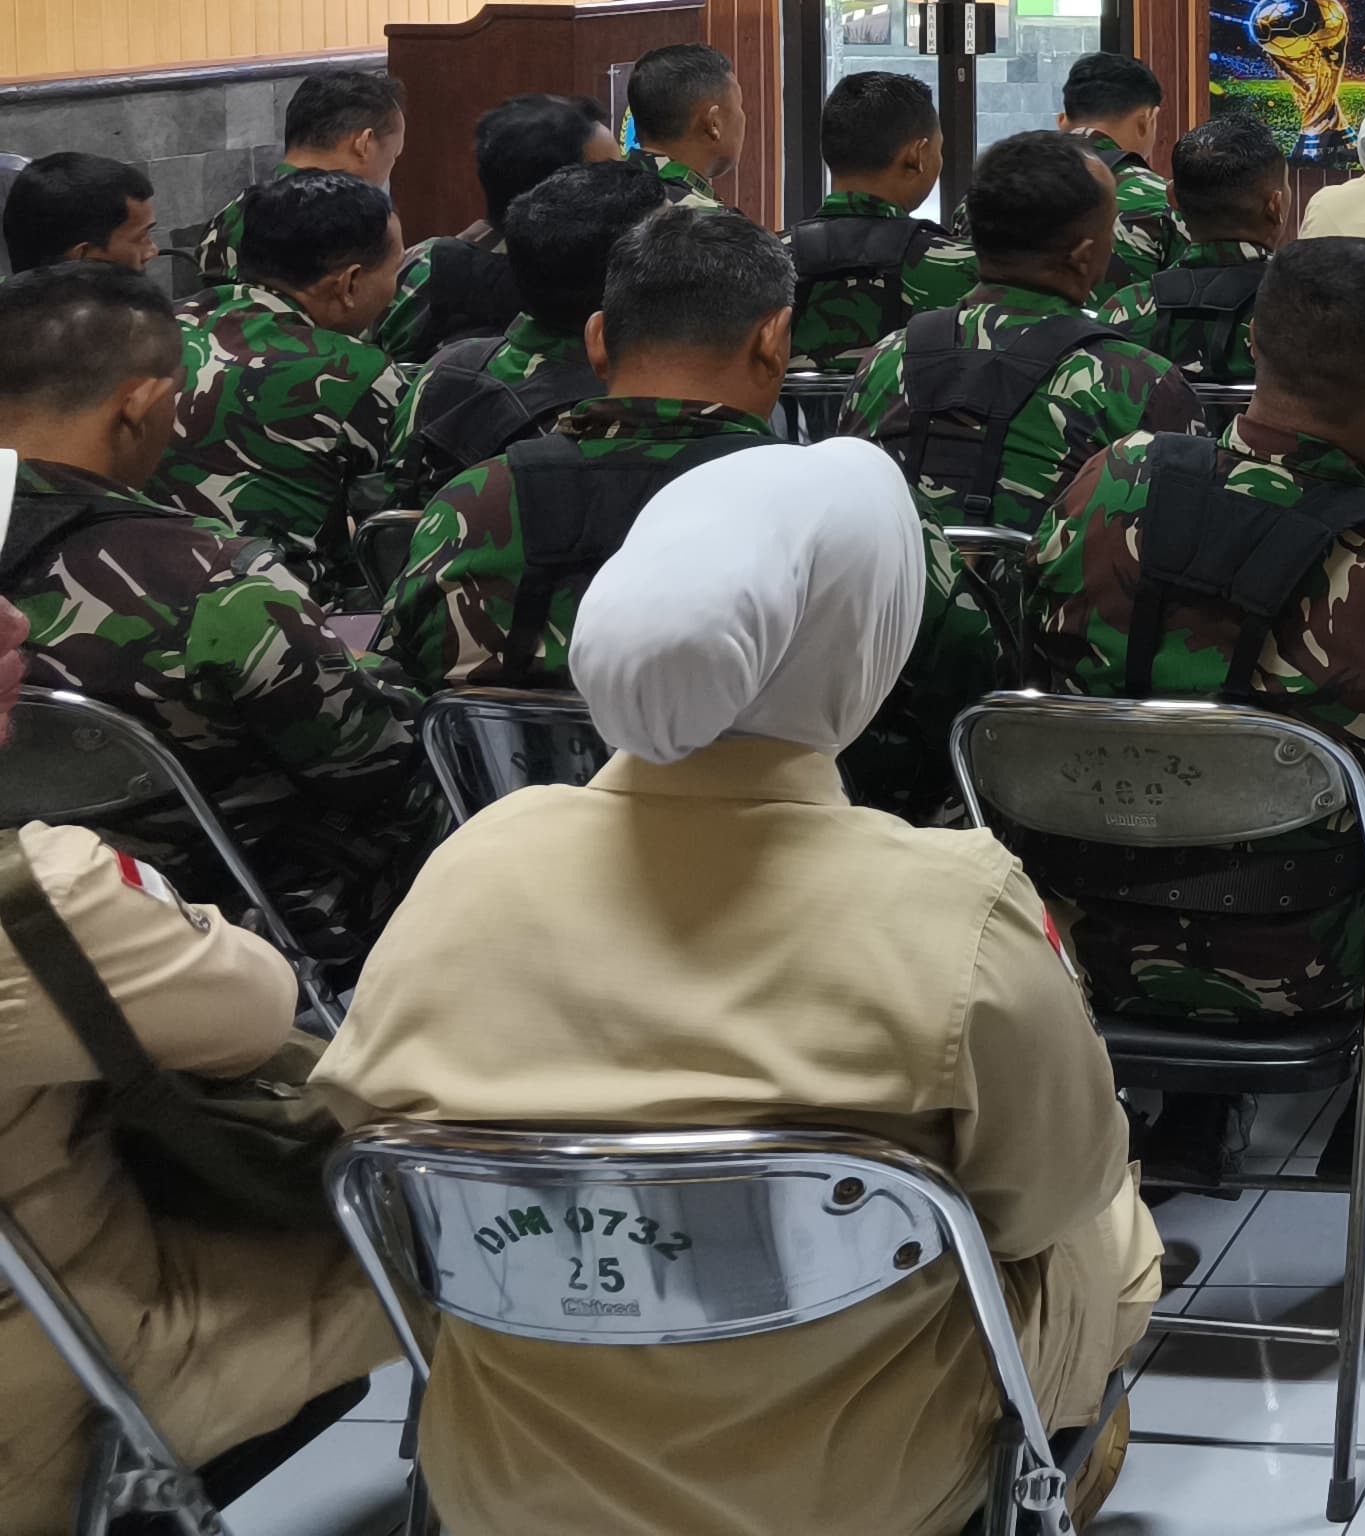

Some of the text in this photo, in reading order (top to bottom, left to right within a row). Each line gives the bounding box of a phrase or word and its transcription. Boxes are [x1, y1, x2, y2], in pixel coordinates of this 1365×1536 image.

[966, 5, 974, 48] TARIK
[474, 1206, 692, 1262] DIM 0732
[568, 1257, 626, 1293] 25
